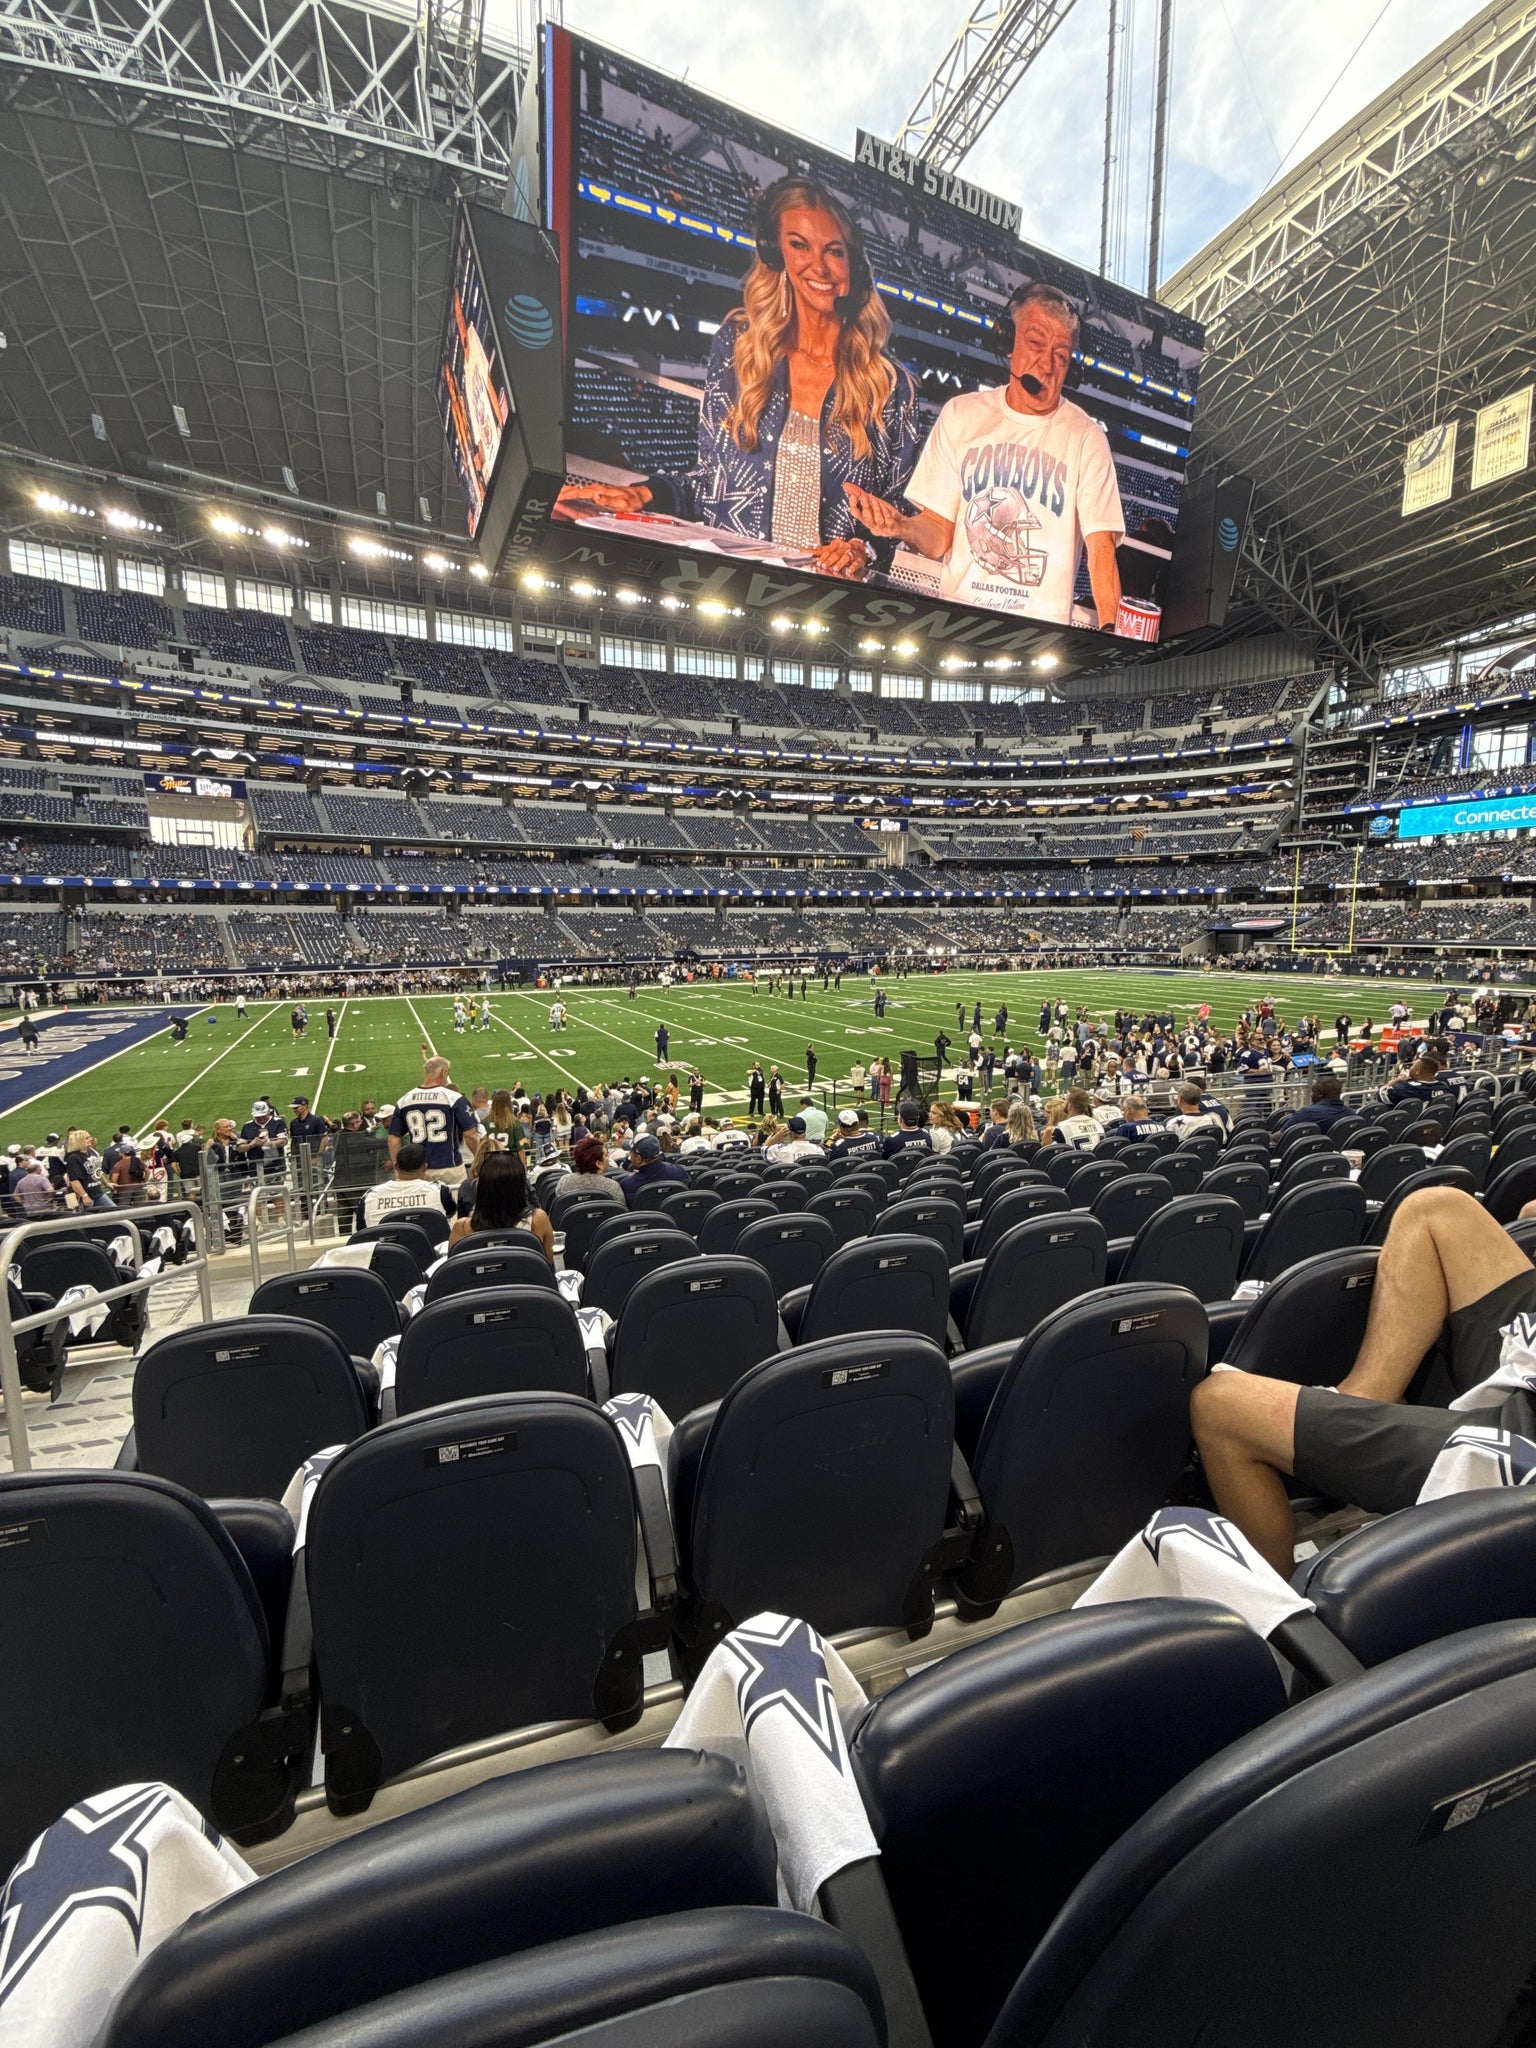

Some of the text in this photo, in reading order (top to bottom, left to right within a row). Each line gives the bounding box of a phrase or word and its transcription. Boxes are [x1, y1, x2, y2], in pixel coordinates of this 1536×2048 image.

[857, 133, 1024, 236] AT&T STADIUM
[961, 442, 1068, 518] COWBOYS
[502, 497, 548, 575] WINSTAR
[971, 581, 1030, 598] DALLAS FOOTBALL
[660, 558, 1066, 655] WINSTAR
[124, 711, 144, 719] JIMMY
[146, 713, 177, 722] JOHNSON
[159, 780, 191, 791] Miller
[1454, 805, 1536, 825] Connecte
[1416, 877, 1469, 886] Blockchain.com
[412, 1092, 439, 1101] WITTEN
[406, 1108, 448, 1144] 82
[1078, 1124, 1098, 1132] SMITH
[377, 1194, 427, 1209] PRESCOTT
